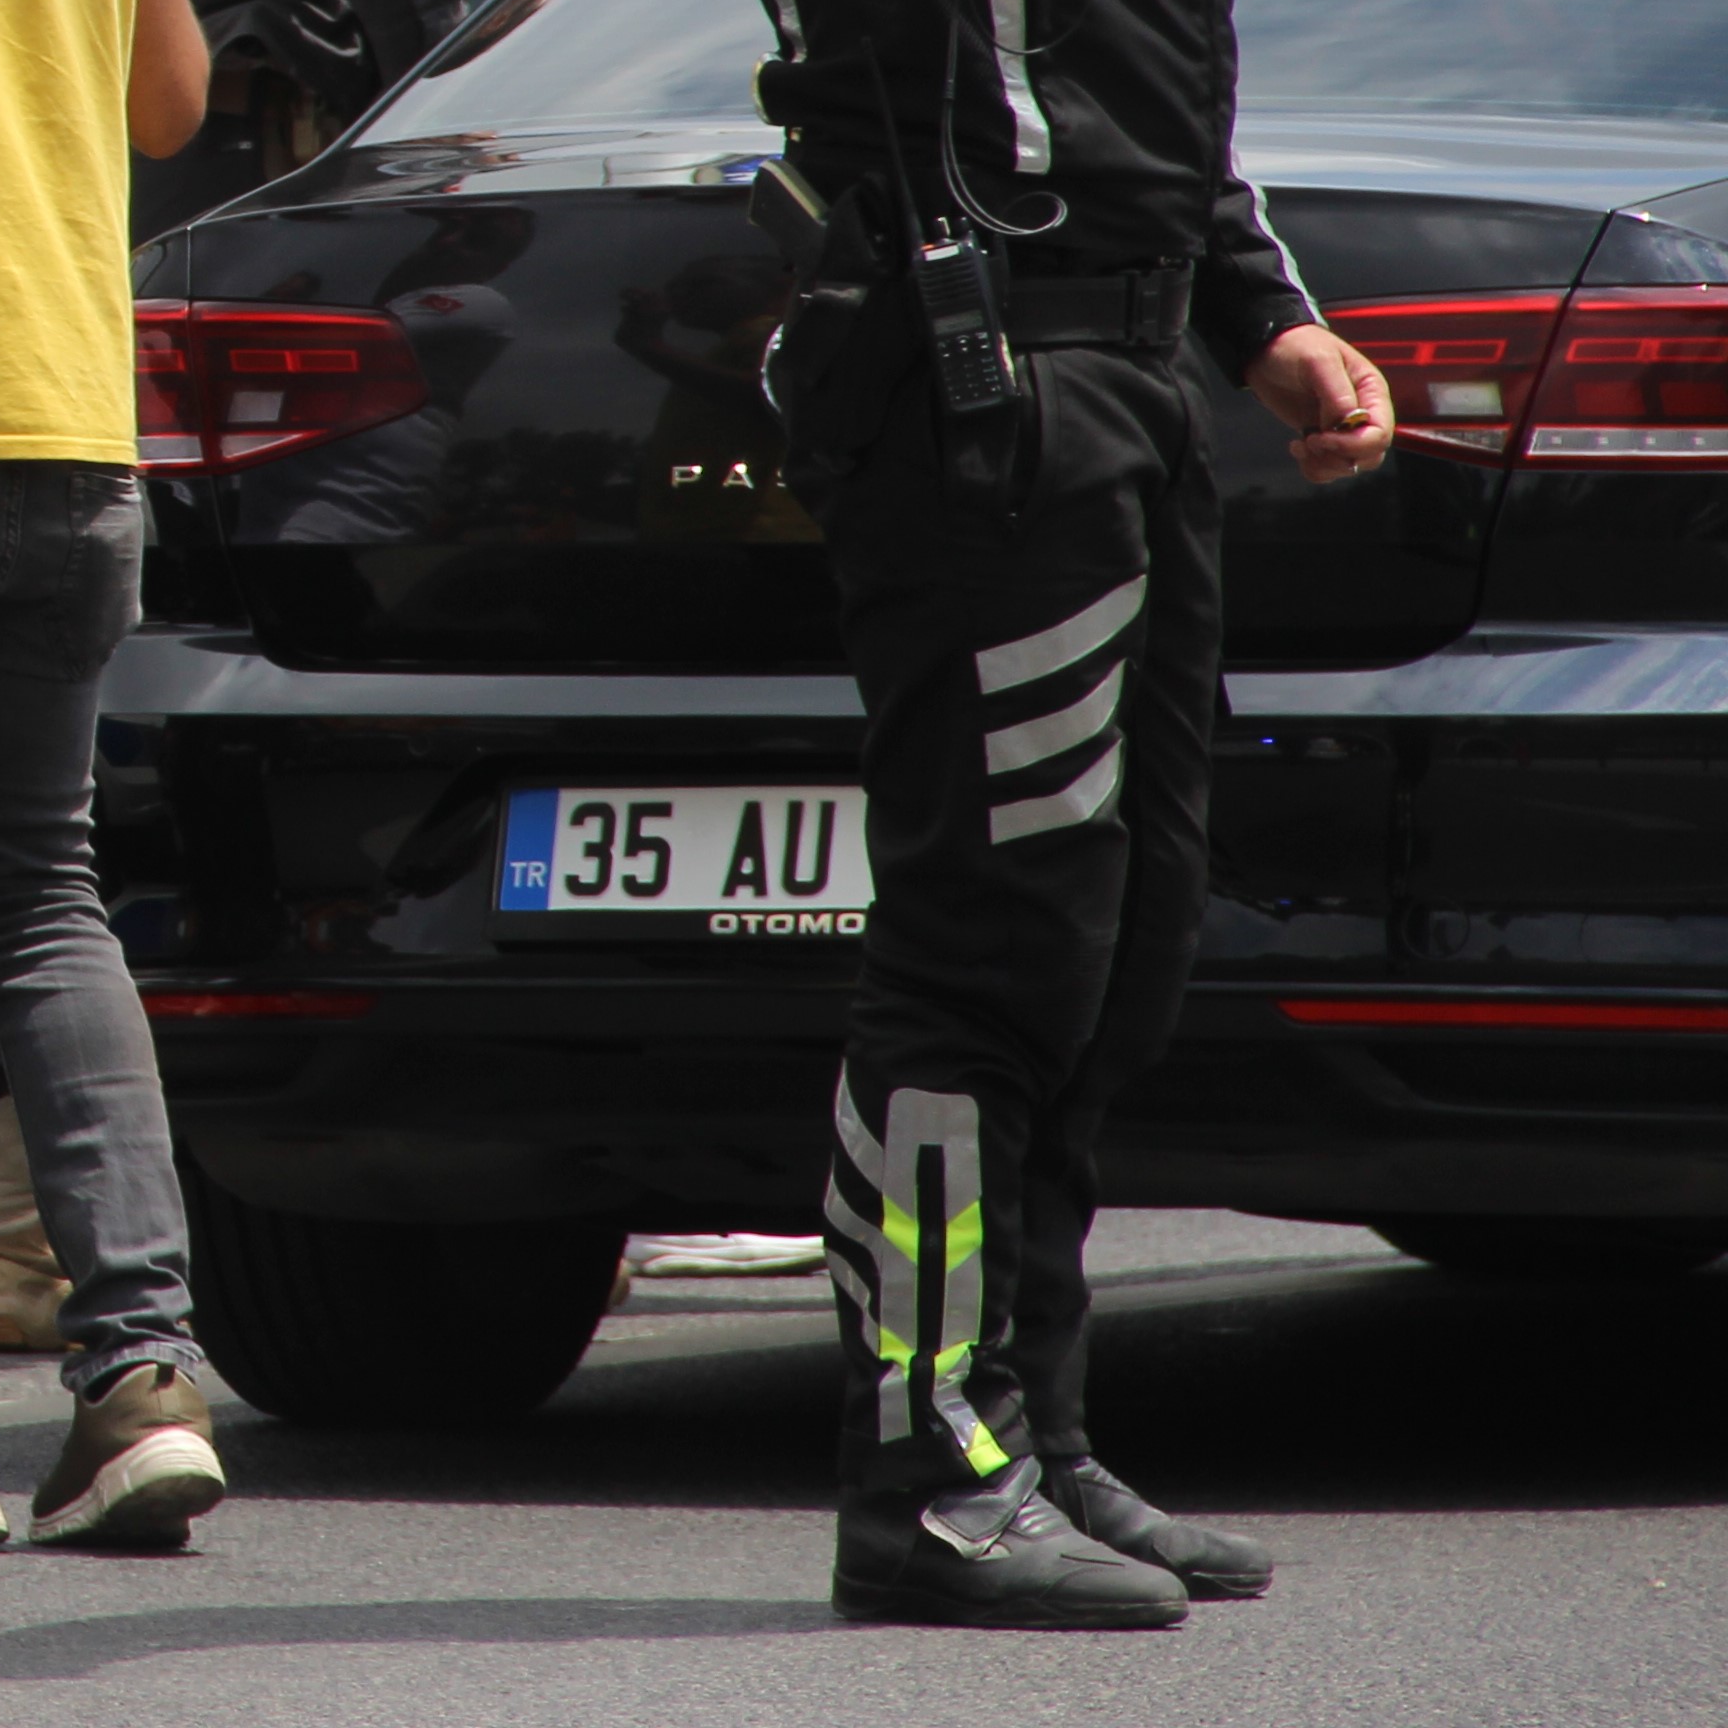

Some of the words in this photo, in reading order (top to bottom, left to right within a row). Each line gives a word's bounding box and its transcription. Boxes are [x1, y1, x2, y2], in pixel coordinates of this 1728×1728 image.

[510, 861, 546, 888] TR
[564, 801, 674, 898] 35
[721, 800, 837, 898] AU
[709, 912, 866, 936] OTOMO
